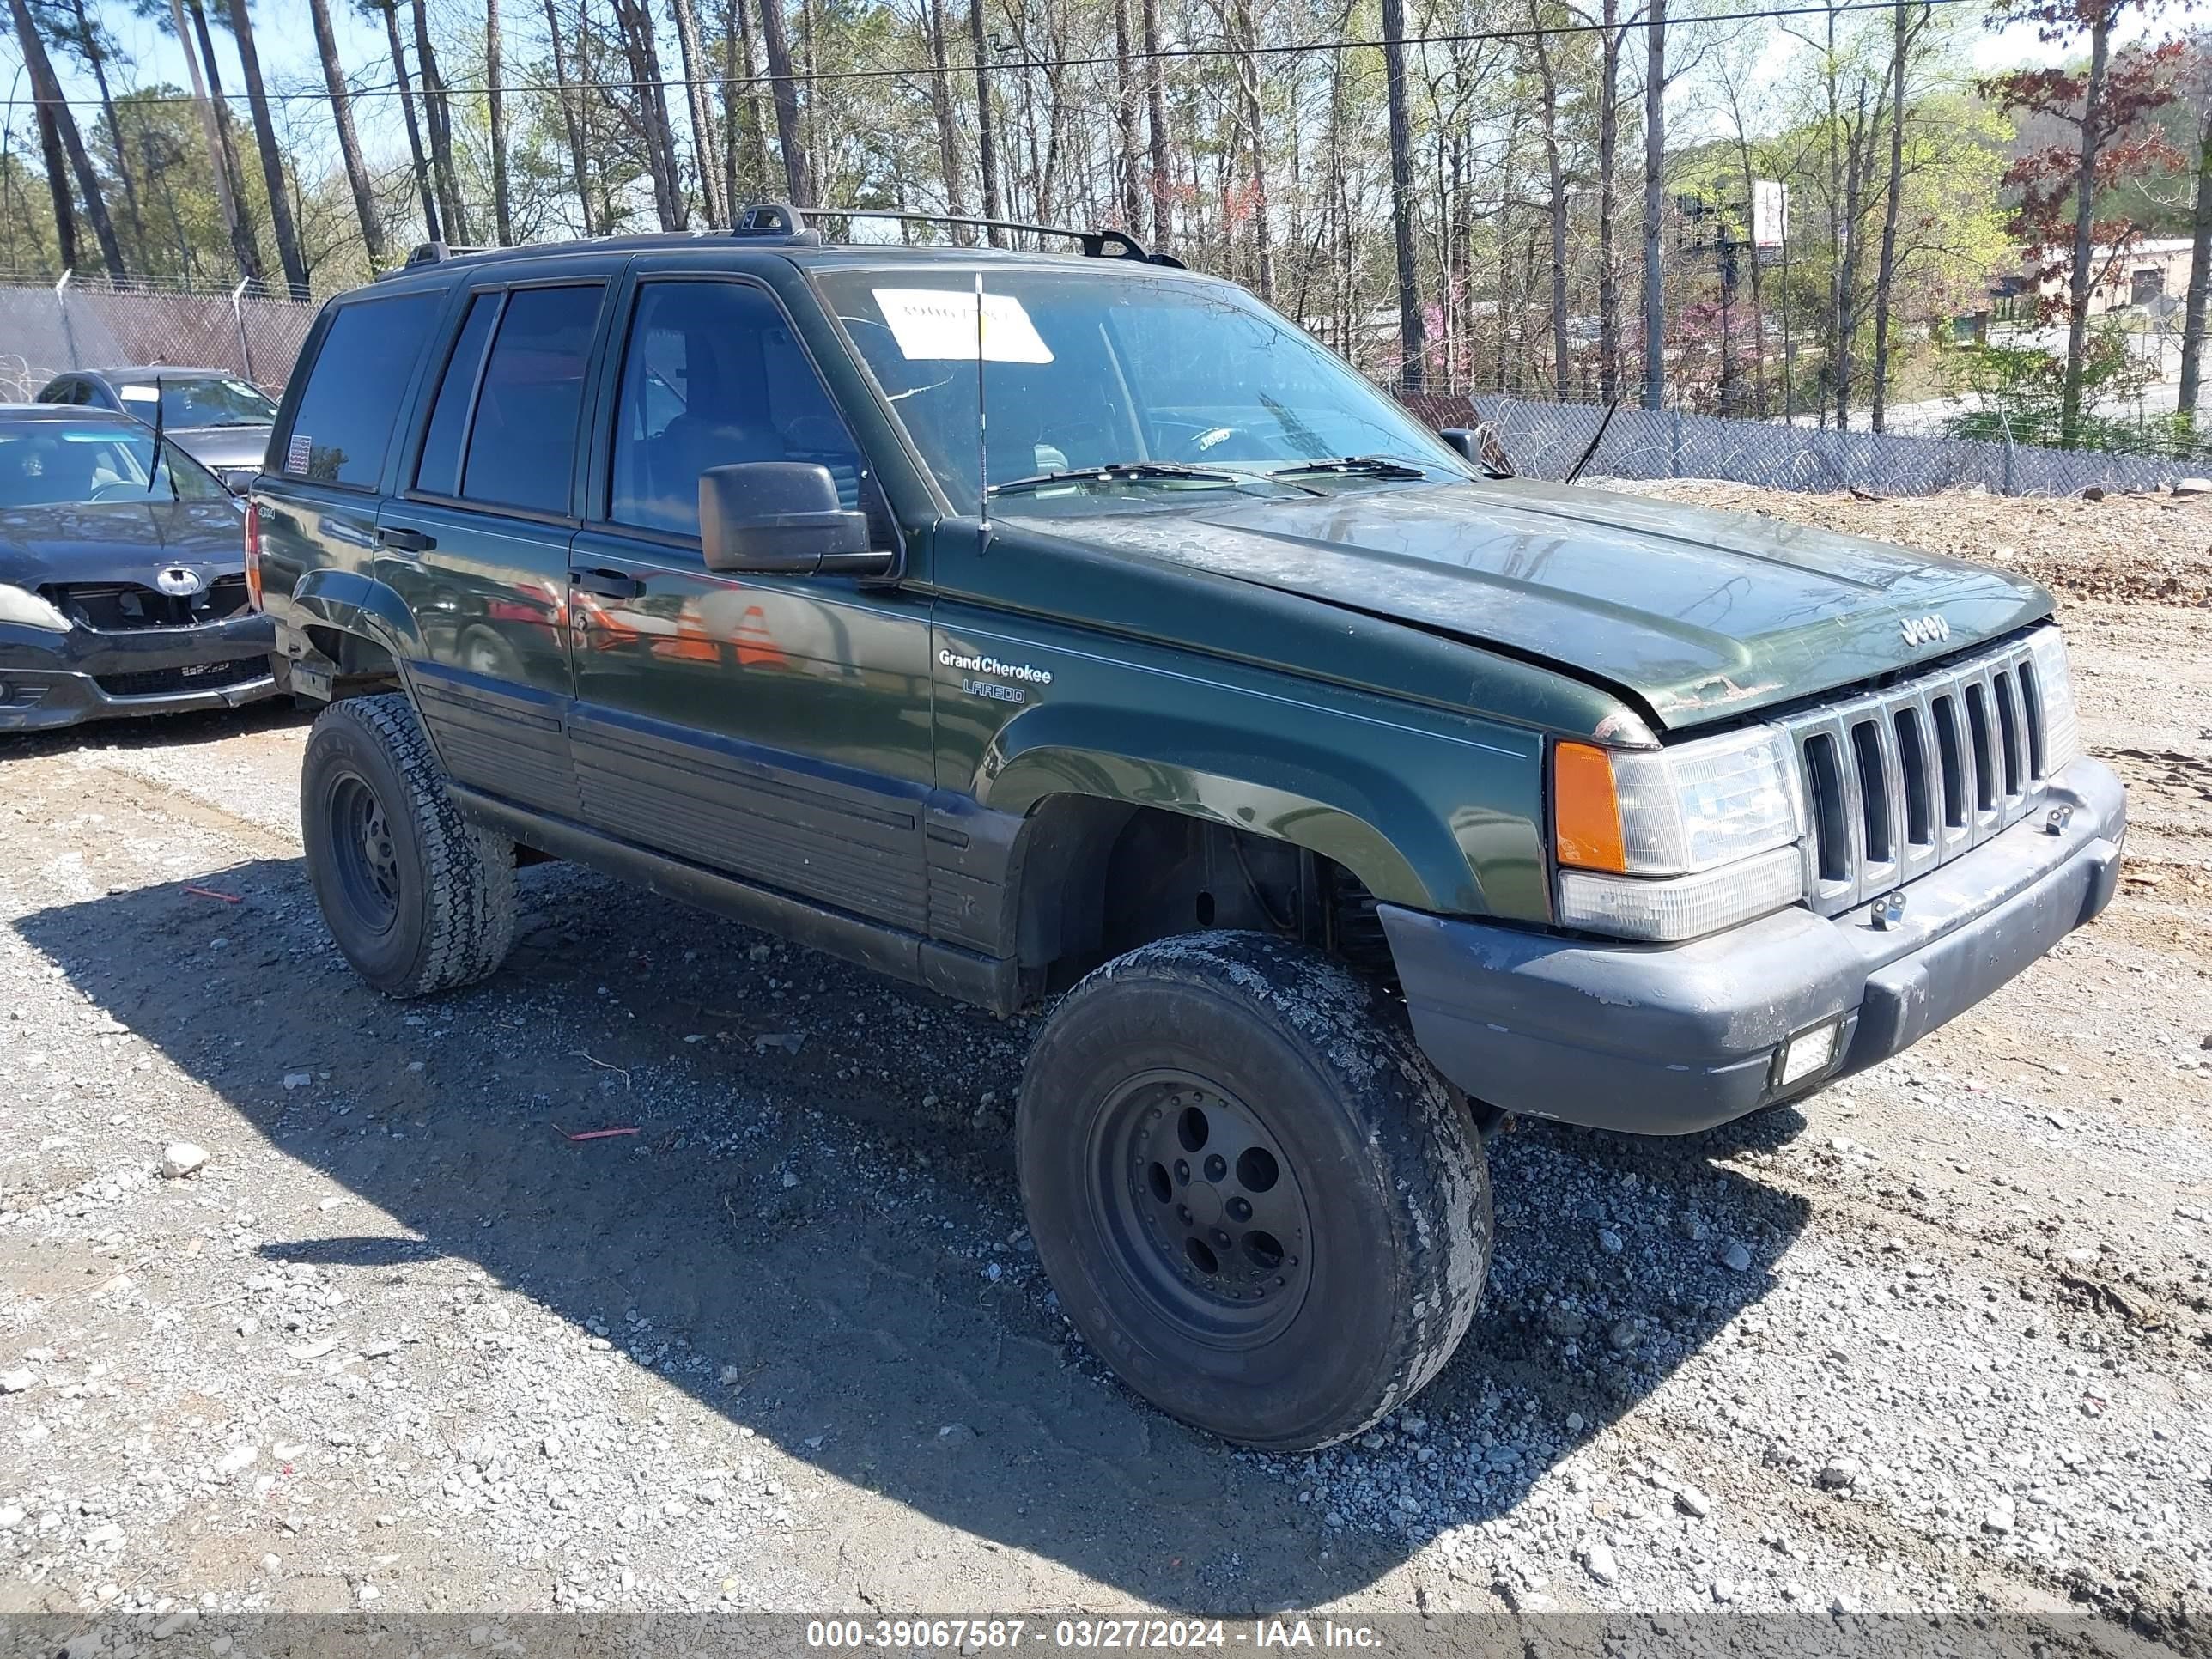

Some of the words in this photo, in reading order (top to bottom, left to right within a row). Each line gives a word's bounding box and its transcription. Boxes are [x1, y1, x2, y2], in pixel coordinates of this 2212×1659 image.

[1900, 613, 1951, 647] Jeep
[939, 649, 981, 672] Grand
[981, 657, 1053, 685] Cherokee
[963, 678, 1025, 704] LAREDO
